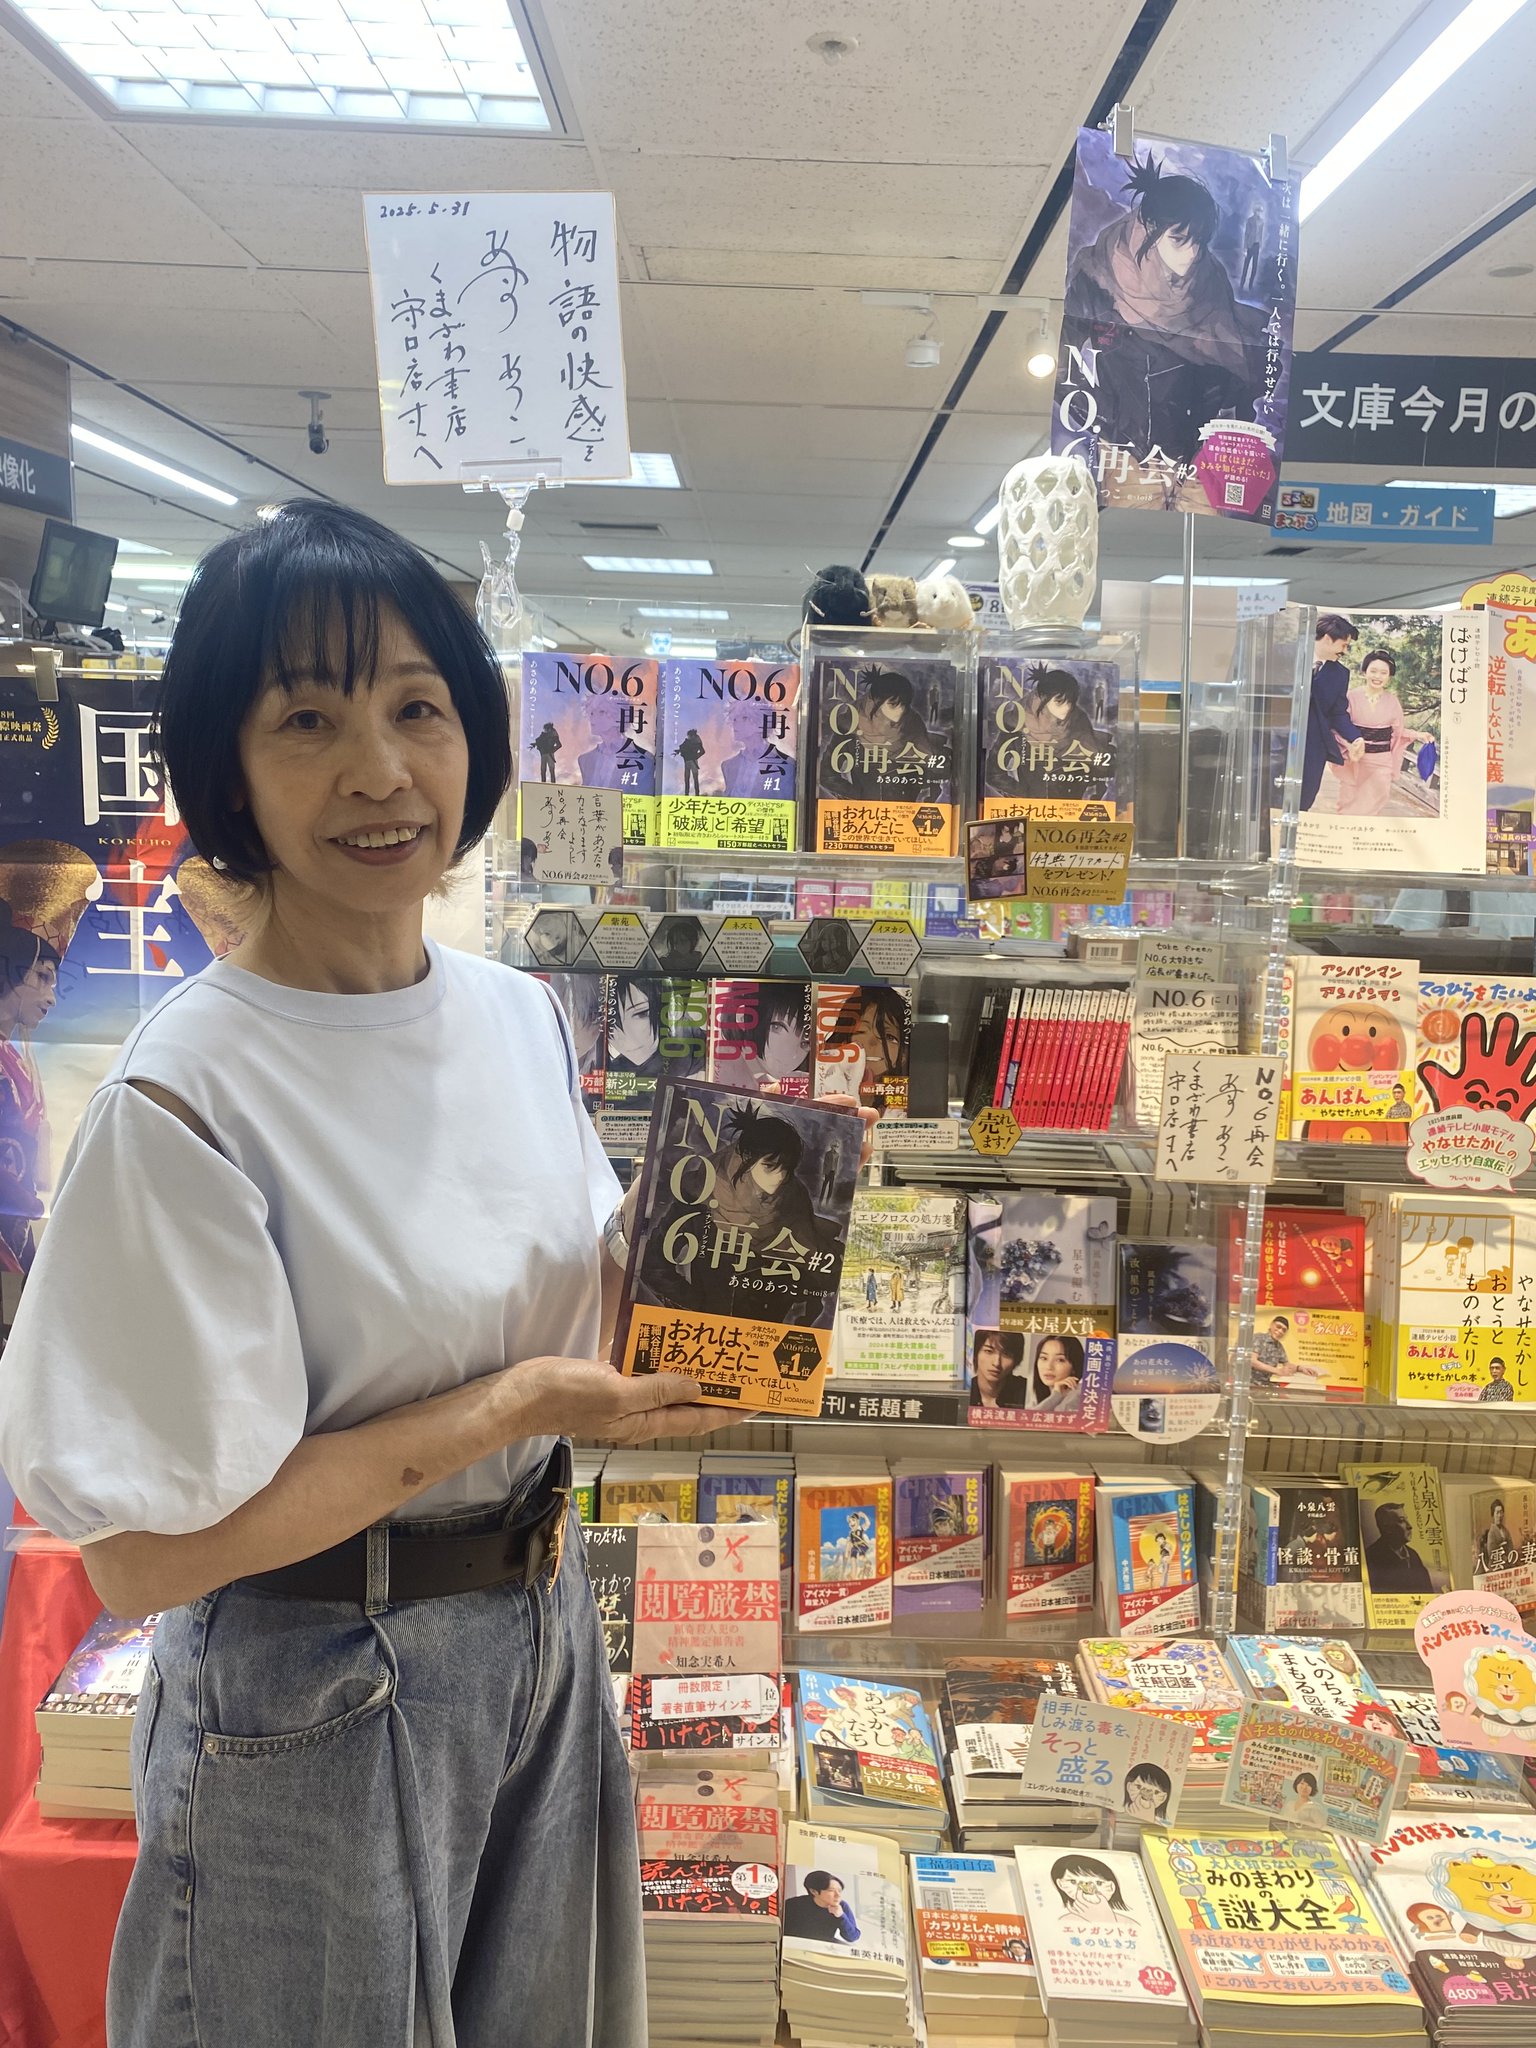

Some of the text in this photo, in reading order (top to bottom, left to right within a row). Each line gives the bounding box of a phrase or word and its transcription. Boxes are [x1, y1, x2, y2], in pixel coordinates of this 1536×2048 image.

[1300, 382, 1536, 433] 文庫今月の
[1274, 511, 1318, 531] まっぷる
[1326, 501, 1469, 529] 地図・ガイド
[1450, 627, 1472, 704] ばけばけ
[529, 660, 538, 711] あさのあつこ
[553, 661, 644, 697] NO.6
[697, 667, 787, 703] NO.6
[673, 667, 682, 718] あさのあつこ
[1487, 656, 1507, 783] 逆転しない正義
[616, 702, 648, 771] 再会
[758, 707, 790, 776] 再会
[621, 772, 638, 786] #1
[764, 777, 781, 791] #1
[876, 776, 923, 784] あさのあつこ
[1043, 774, 1090, 783] あさのあつこ
[669, 799, 746, 815] 少年たちの
[842, 806, 896, 822] おれは、
[668, 814, 772, 835] 「破滅」と「希望」
[842, 821, 904, 835] あんたに
[98, 837, 173, 846] KOKUHO
[1043, 870, 1114, 881] をプレゼント!
[611, 917, 630, 926] 紫苑
[732, 922, 753, 930] ネズミ
[877, 926, 907, 934] イヌカシ
[1152, 990, 1206, 1008] NO.6
[1320, 986, 1401, 1002] アンパンマン
[1419, 981, 1486, 1002] てのひらを
[608, 980, 617, 1035] あさのあつこ
[803, 984, 811, 1041] あさのあつこ
[713, 981, 760, 1061] NO.6
[817, 985, 862, 1063] NO.6
[903, 990, 912, 1045] あさのあつこ
[606, 1078, 657, 1090] 新シリーズ
[885, 1095, 908, 1105] 発売!!
[1300, 1087, 1371, 1105] あんぱん
[1320, 1109, 1384, 1117] やなせたかしの本
[978, 1112, 1015, 1134] 売れて
[1427, 1122, 1515, 1143] 連続テレビ小説モデル
[983, 1135, 1011, 1150] ます!
[1422, 1135, 1518, 1160] やなせたかしの
[1418, 1155, 1514, 1175] エッセイや自叙伝!
[857, 1213, 954, 1227] エピクロスの処方箋
[883, 1232, 927, 1242] 夏川草介
[728, 1275, 799, 1297] あさのあつこ
[1491, 1275, 1507, 1345] おとうと
[845, 1314, 960, 1326] 「医療では、人は救えないんだよ」
[1025, 1316, 1097, 1335] 本屋大賞
[1462, 1273, 1480, 1367] ものがたり
[668, 1319, 750, 1350] おれは、
[744, 1333, 780, 1342] ディストピア小説
[751, 1325, 777, 1334] 少年たちの
[1516, 1275, 1533, 1387] やなせたかし
[638, 1325, 650, 1363] 推薦!
[649, 1325, 661, 1369] 細谷佳正
[1408, 1345, 1458, 1358] あんぱん
[664, 1343, 759, 1372] あんたに
[780, 1353, 810, 1377] 第1位
[1441, 1362, 1461, 1370] モデル
[1081, 1341, 1104, 1430] 映画化決定!
[1409, 1372, 1477, 1381] やなせたかしの本
[784, 1397, 815, 1405] KODANSHA
[971, 1409, 1077, 1424] 横浜流星 広瀬すず
[605, 1484, 667, 1505] GEN
[703, 1478, 765, 1496] GEN
[1015, 1483, 1067, 1504] GEN
[807, 1488, 866, 1508] GEN
[1116, 1494, 1169, 1518] GEN
[1297, 1502, 1336, 1512] 小泉八雲
[1078, 1482, 1090, 1551] はだしのゲン
[1417, 1470, 1443, 1546] 小泉八雲
[877, 1488, 889, 1575] はだしのゲン 4
[1177, 1493, 1193, 1582] はだしのゲン 7
[1277, 1547, 1360, 1566] 怪談・骨董
[1473, 1541, 1536, 1575] 八雲の妻
[929, 1570, 965, 1580] 日本被団協
[635, 1582, 777, 1620] 閲覧厳禁
[1041, 1595, 1076, 1607] 日本被団協
[837, 1613, 875, 1624] 日本被団協
[1153, 1621, 1186, 1634] 日本被団協
[1376, 1618, 1406, 1626] 平凡社新書
[668, 1636, 744, 1647] 精神鑑定報告書
[677, 1655, 736, 1668] 知念実希人
[1131, 1663, 1190, 1676] ポケモン
[678, 1680, 730, 1694] 冊数限定!
[1135, 1677, 1197, 1689] 生態図鑑
[1304, 1655, 1350, 1710] いのちを
[766, 1688, 776, 1701] 位
[661, 1699, 752, 1715] 著者直筆サイン本
[1042, 1700, 1087, 1716] 相手に
[864, 1692, 890, 1747] あやかし
[1041, 1716, 1130, 1739] しみ渡る毒を、
[736, 1735, 778, 1746] サイン本
[847, 1718, 868, 1746] たち
[864, 1767, 902, 1780] しゃばけ
[1056, 1756, 1113, 1786] 盛る
[864, 1775, 926, 1794] TVアニメ化
[642, 1805, 773, 1833] 閲覧厳禁
[799, 1828, 848, 1843] 独断と偏見
[928, 1856, 994, 1872] 福翁自伝
[1211, 1860, 1298, 1870] 大人も知らない
[1206, 1869, 1315, 1889] みのまわり
[1259, 1890, 1273, 1898] の
[922, 1911, 978, 1922] 日本に必要な
[1218, 1899, 1337, 1932] 謎大全
[922, 1920, 1026, 1937] 「カラリとした精神」
[926, 1931, 1000, 1943] がここにあります。
[1063, 1926, 1138, 1937] エレガントな
[1070, 1936, 1137, 1950] 毒の吐き方
[1189, 1932, 1392, 1954] 身近な「なぜ?」がぜんぶわかる!
[850, 1948, 905, 1967] 集英社新書
[1054, 1976, 1132, 1988] 大人の上手な伝え方
[1145, 1969, 1165, 1980] 10
[1215, 1976, 1386, 1994] この世っておもしろすぎる。
